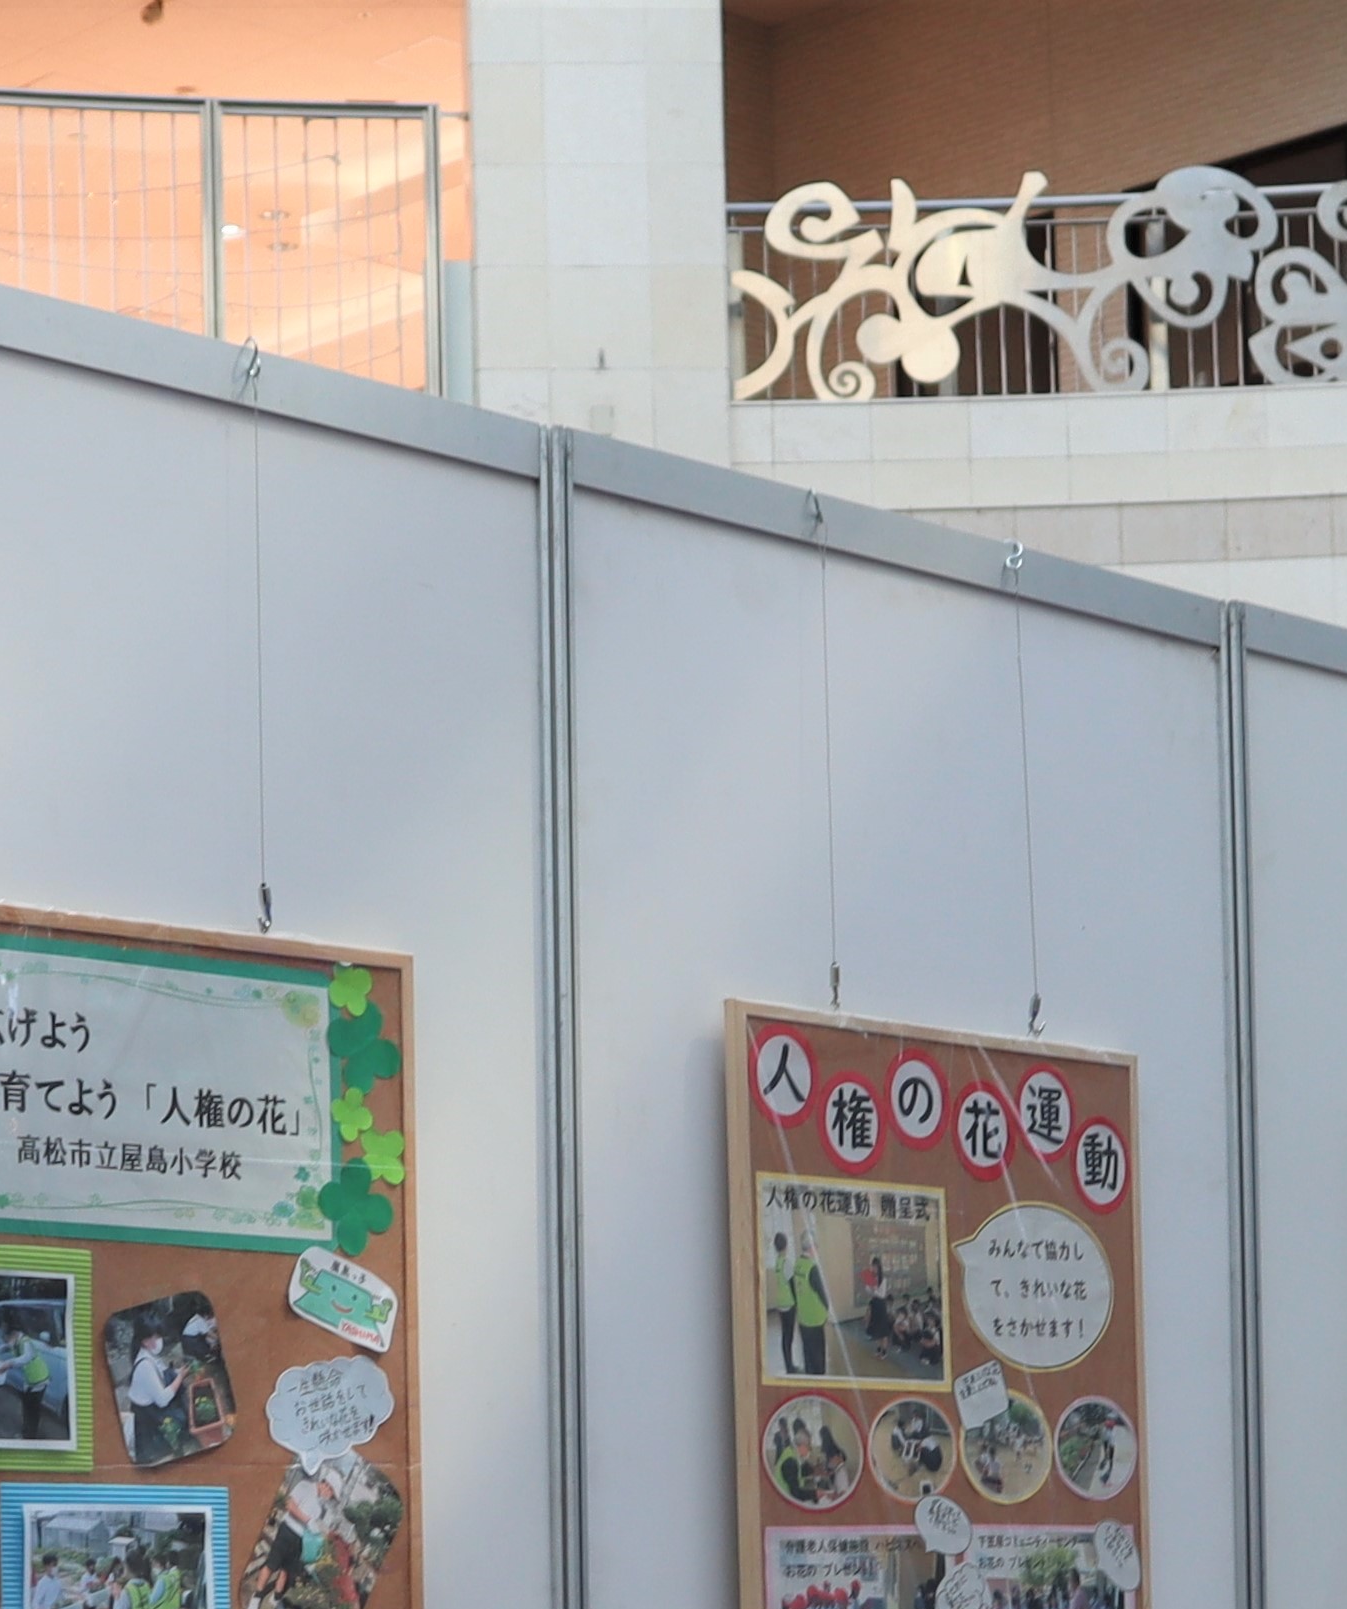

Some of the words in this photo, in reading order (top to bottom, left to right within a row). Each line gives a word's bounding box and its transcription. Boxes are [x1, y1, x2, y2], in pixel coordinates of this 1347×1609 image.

[16, 1134, 243, 1180] 高松市立屋島小学校
[763, 1043, 1120, 1192] 人権の花運動
